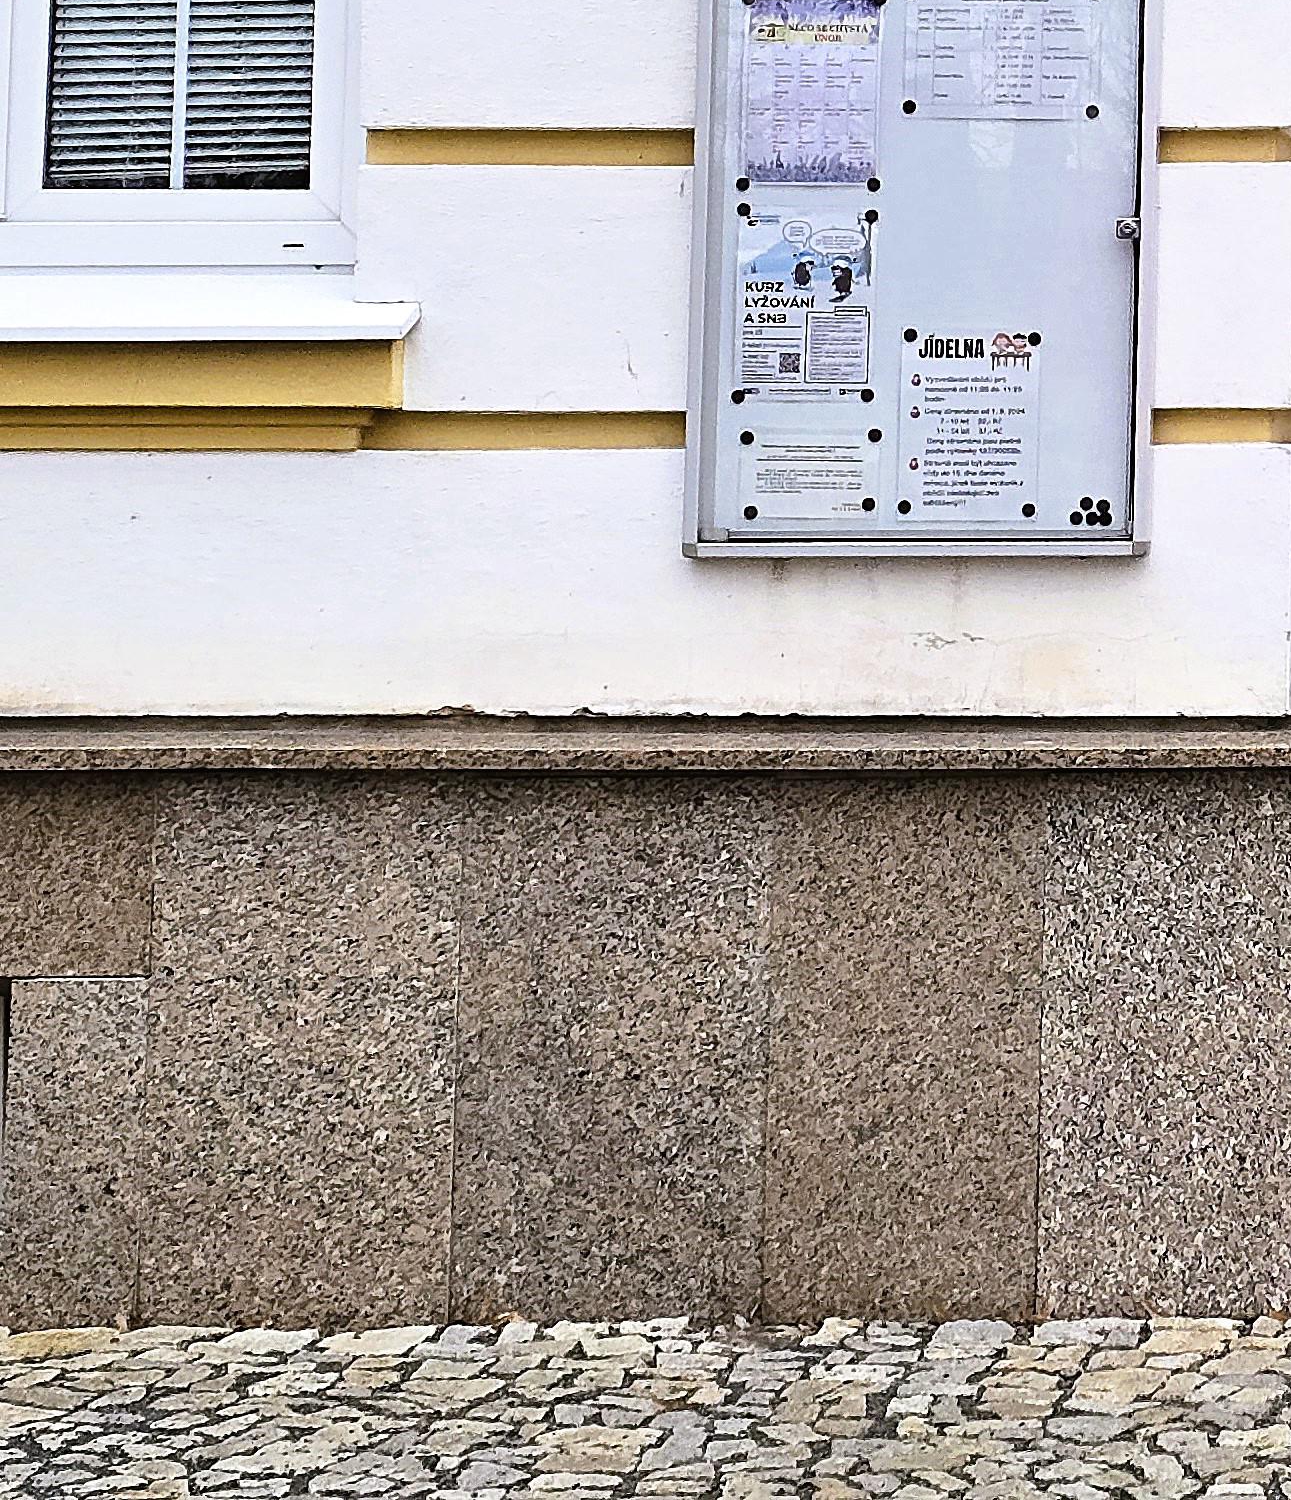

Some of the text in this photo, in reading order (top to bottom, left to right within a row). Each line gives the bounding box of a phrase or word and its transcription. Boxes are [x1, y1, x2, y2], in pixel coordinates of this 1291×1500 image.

[744, 294, 815, 308] LYŽOVÁNÍ
[743, 313, 754, 324] A
[918, 333, 985, 359] JÍDELNA
